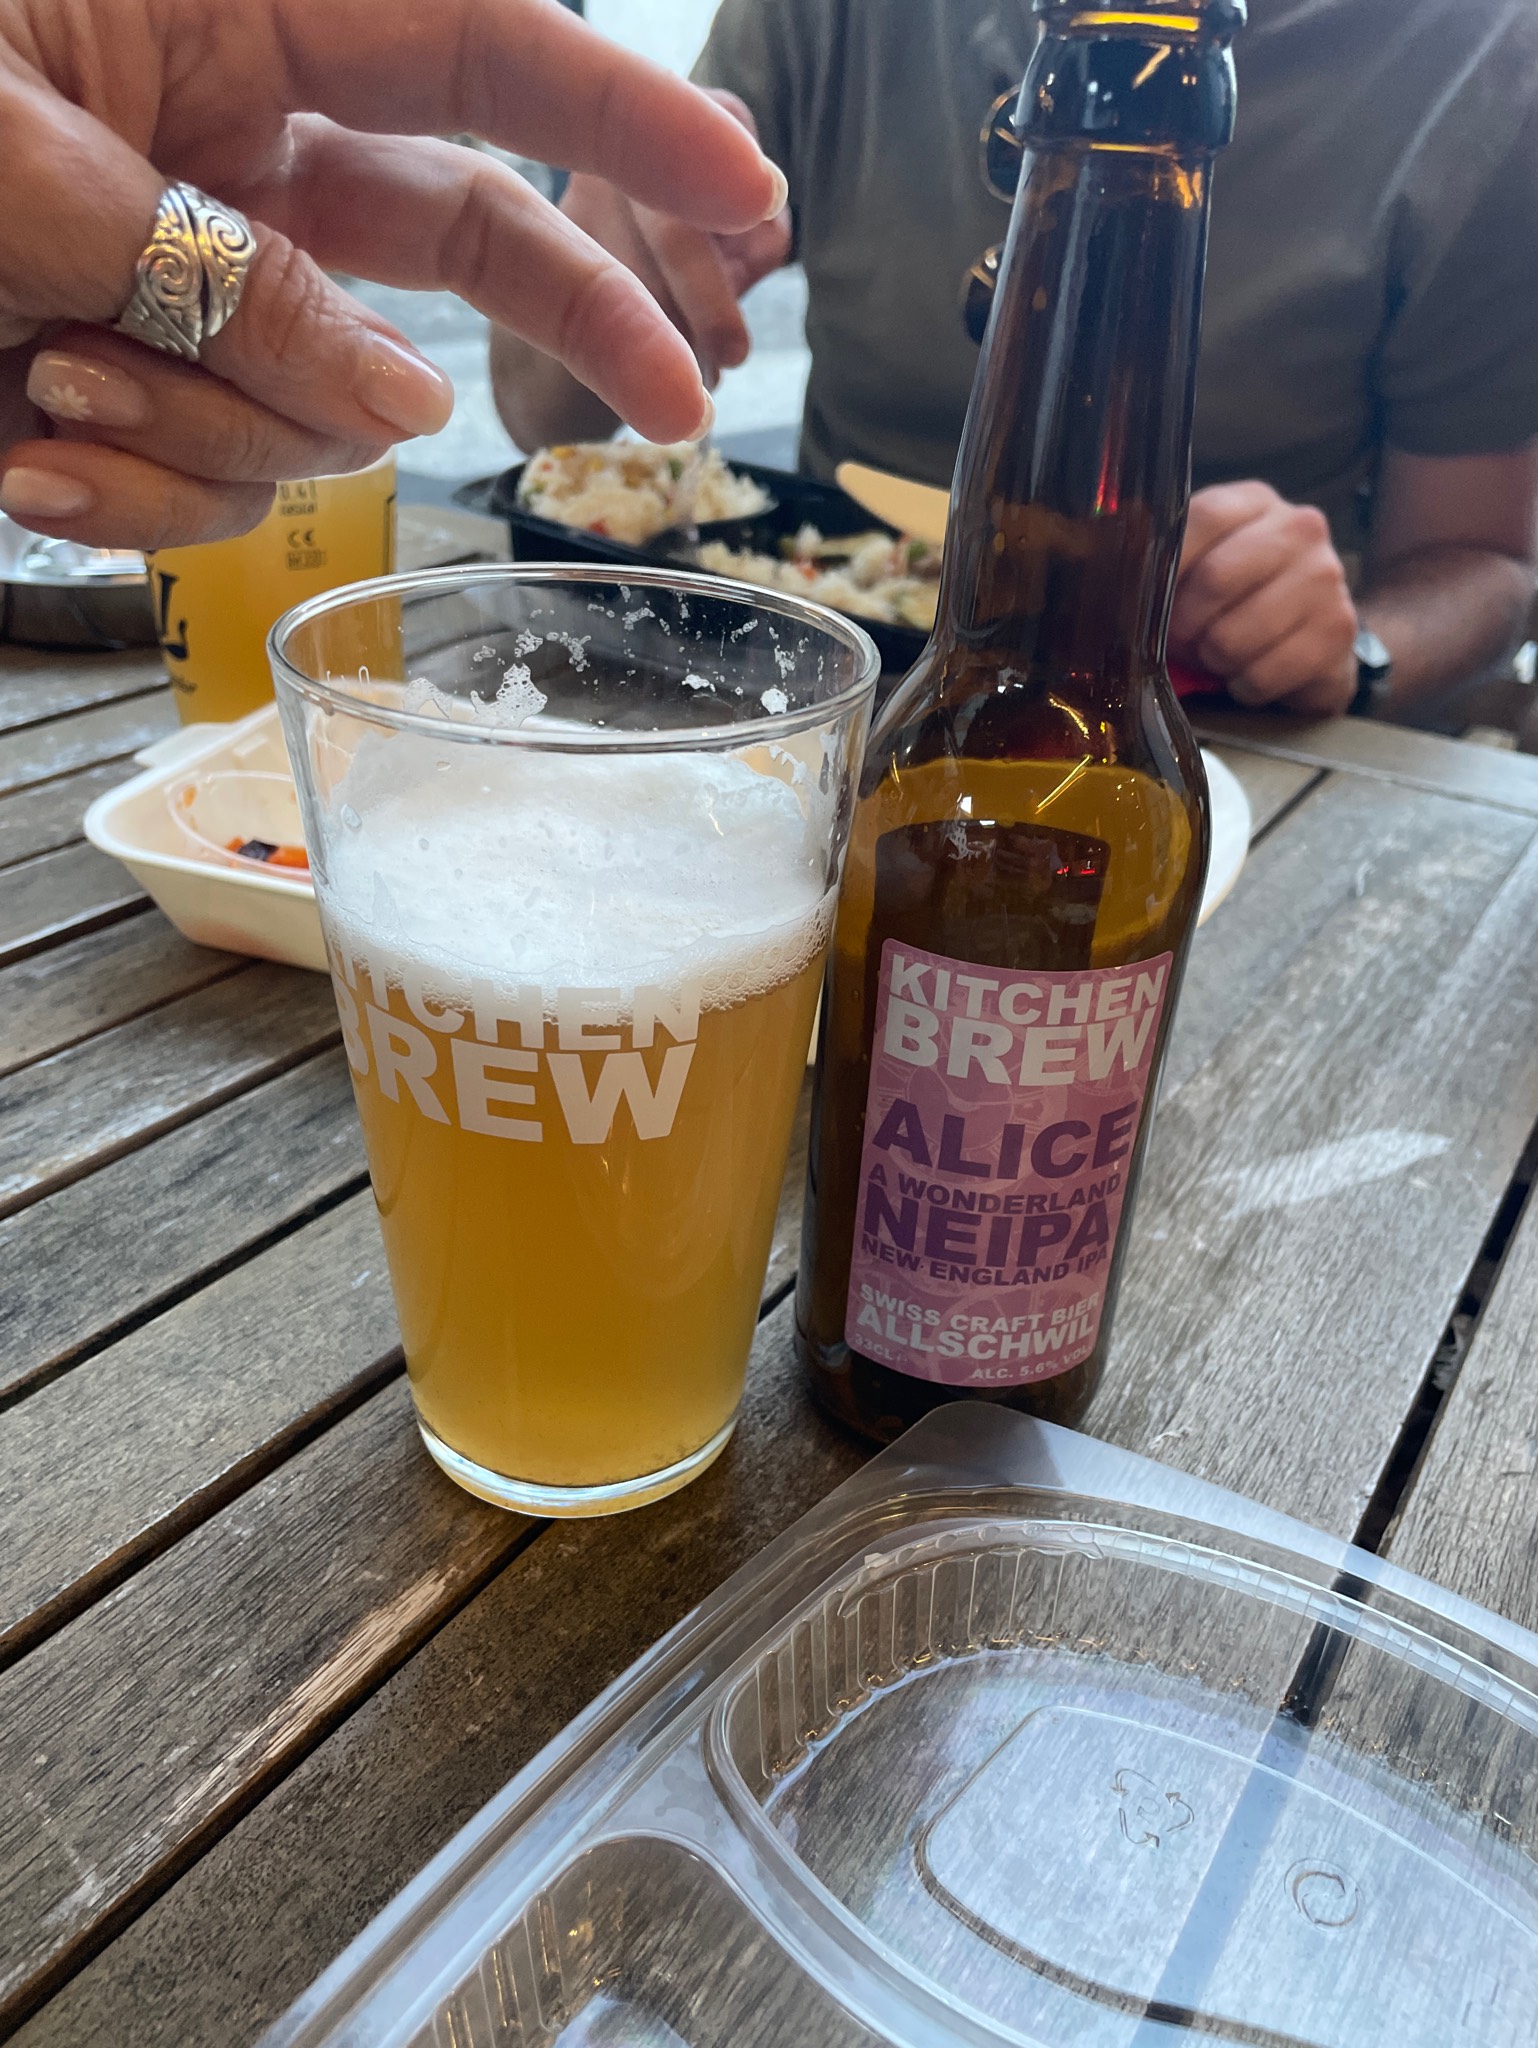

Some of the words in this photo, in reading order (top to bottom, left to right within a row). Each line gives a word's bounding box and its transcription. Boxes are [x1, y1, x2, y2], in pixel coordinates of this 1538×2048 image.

[326, 922, 700, 1050] ITCHEN
[889, 953, 1166, 1026] KITCHEN
[883, 995, 1158, 1087] BREW
[872, 1097, 1138, 1180] ALICE
[868, 1162, 888, 1187] A
[898, 1172, 1122, 1215] WONDERLAND
[863, 1182, 1111, 1268] NEIPA
[929, 1261, 1070, 1287] ENGLAND
[1077, 1244, 1108, 1274] IPA
[856, 1304, 1095, 1361] ALLSCHWIL
[860, 1283, 942, 1327] SWISS
[949, 1313, 1045, 1334] CRAFT
[1050, 1291, 1100, 1327] BIER
[971, 1367, 1014, 1379] ALC.
